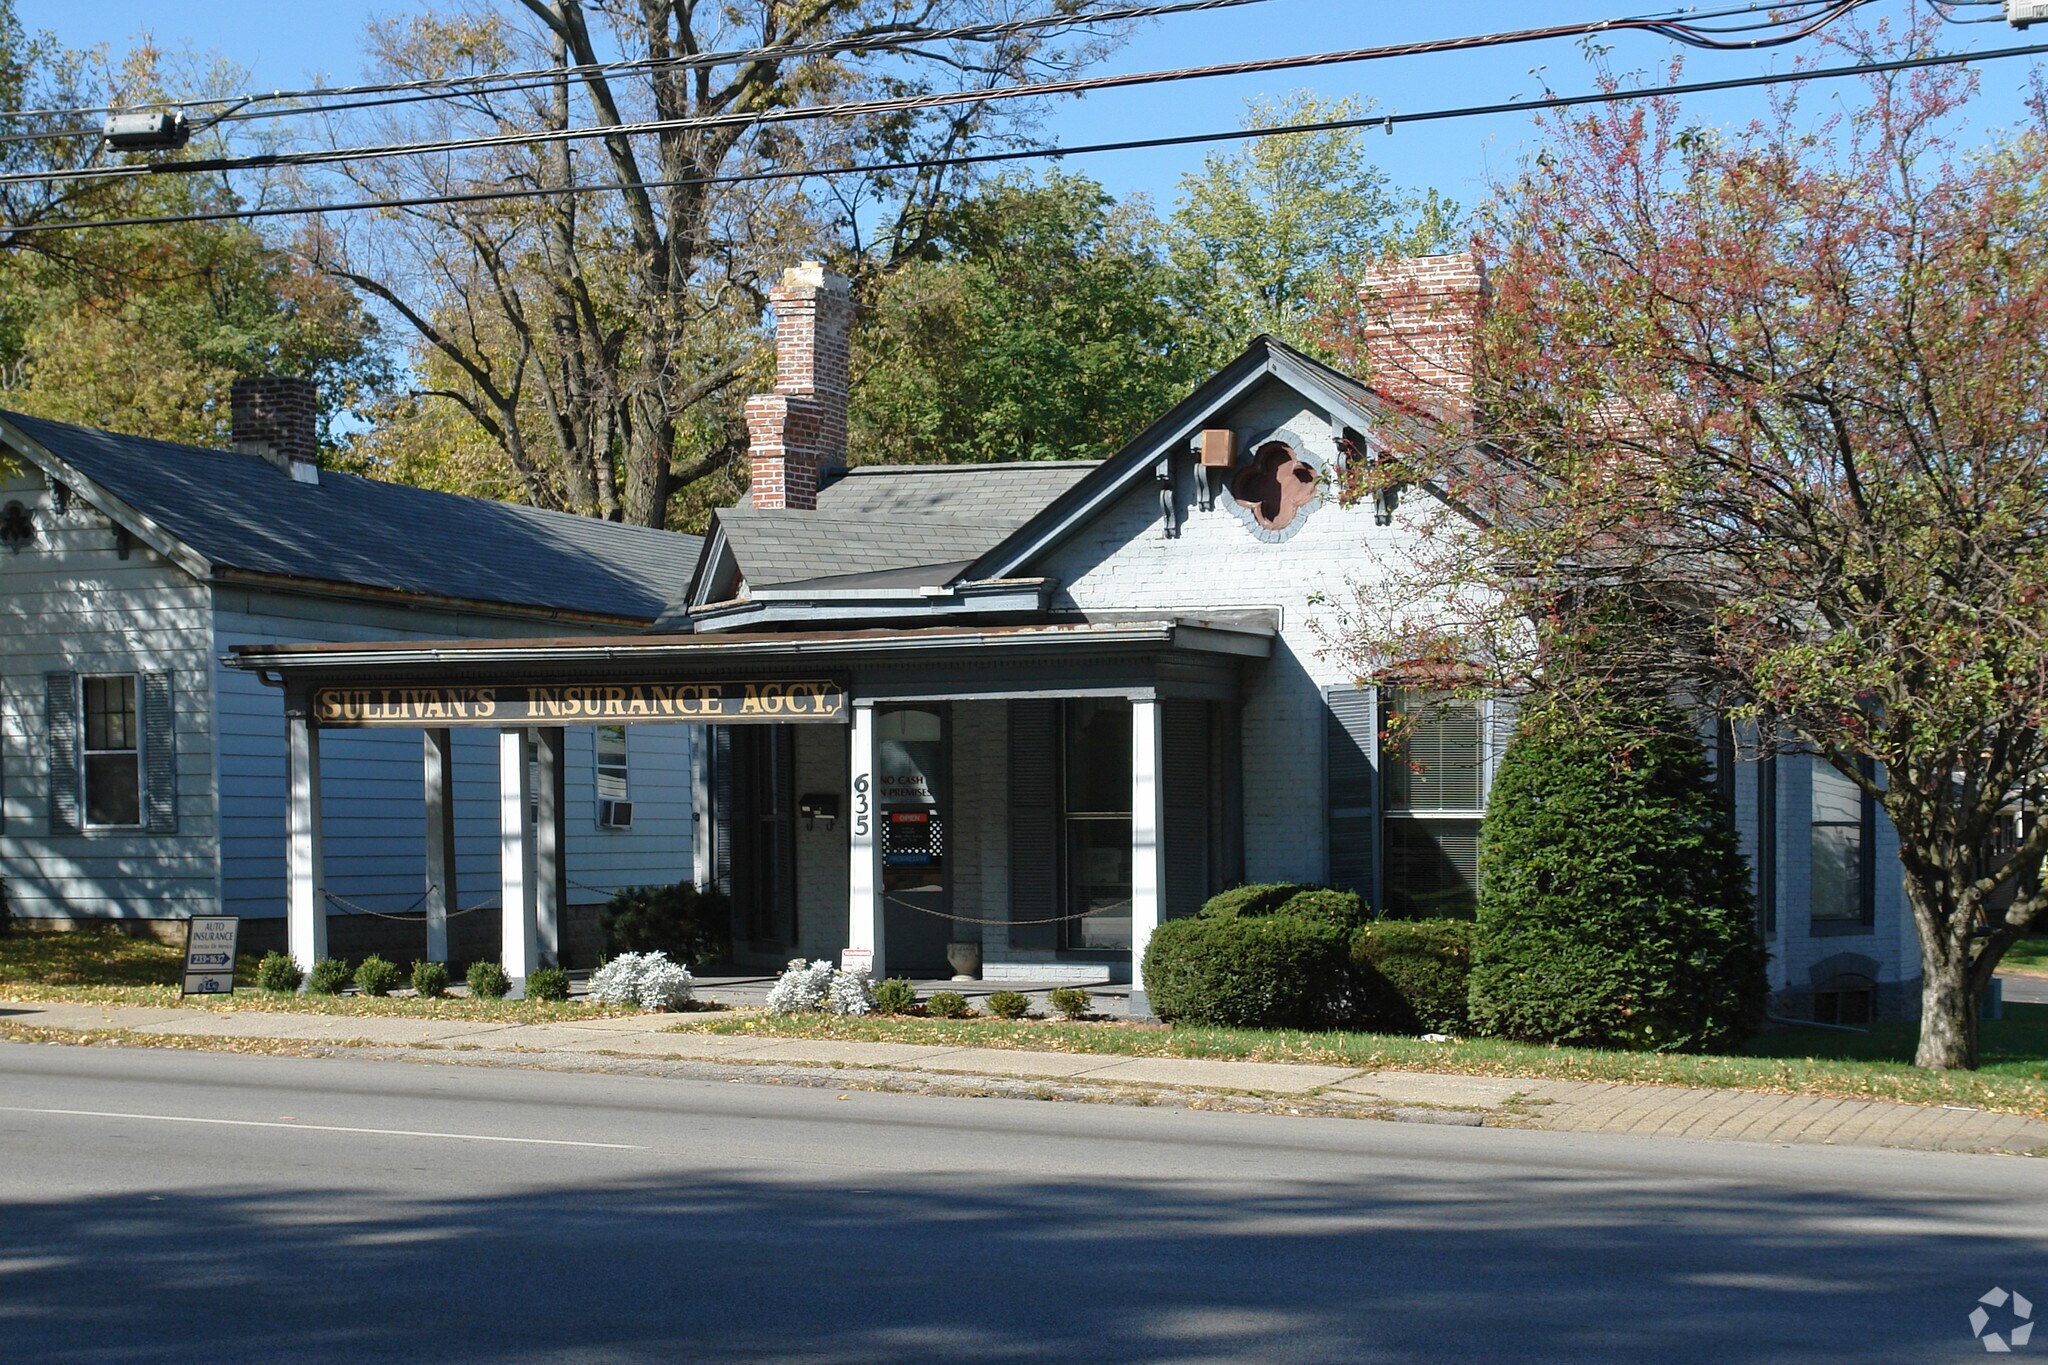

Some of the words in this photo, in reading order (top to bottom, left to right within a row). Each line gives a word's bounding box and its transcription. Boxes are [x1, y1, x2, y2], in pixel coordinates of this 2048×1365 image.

[321, 688, 496, 720] SULLIVAN'S
[527, 684, 723, 717] INSURANCE
[739, 682, 834, 714] AGCY.
[880, 775, 895, 785] NO
[898, 775, 923, 785] CASH
[889, 788, 933, 797] PREMISES
[854, 773, 870, 836] 635
[205, 922, 225, 931] AUTO
[193, 931, 233, 941] INSURANCE
[193, 955, 225, 964] 233-1637
